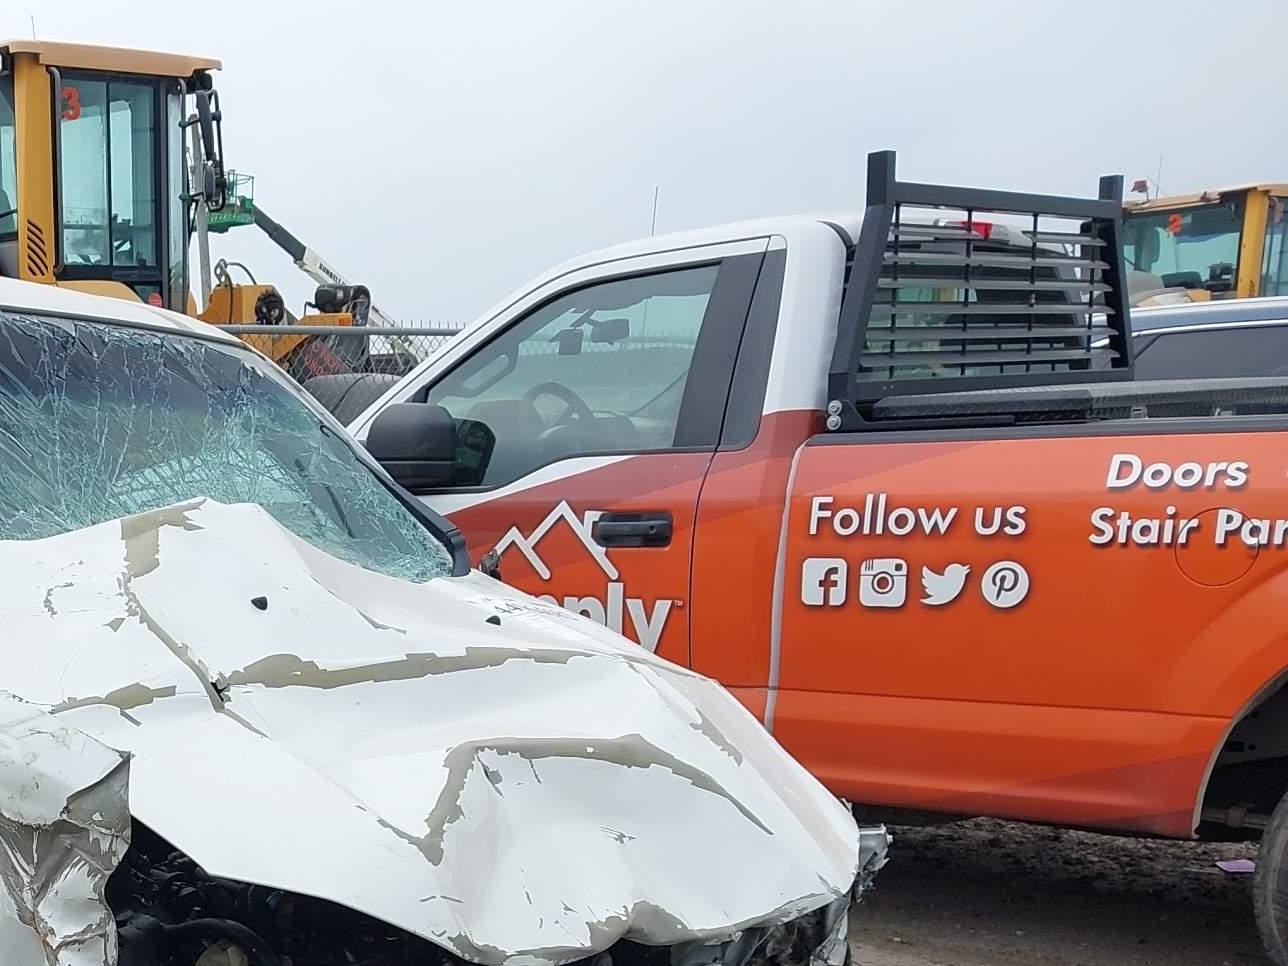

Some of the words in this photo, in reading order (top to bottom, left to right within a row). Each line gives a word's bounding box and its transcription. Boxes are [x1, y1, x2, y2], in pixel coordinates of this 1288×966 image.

[62, 87, 81, 120] 3
[1167, 213, 1182, 233] 2
[1105, 453, 1249, 488] Doors
[808, 493, 958, 536] Follow
[974, 506, 1027, 536] us
[1088, 506, 1199, 544] Stair
